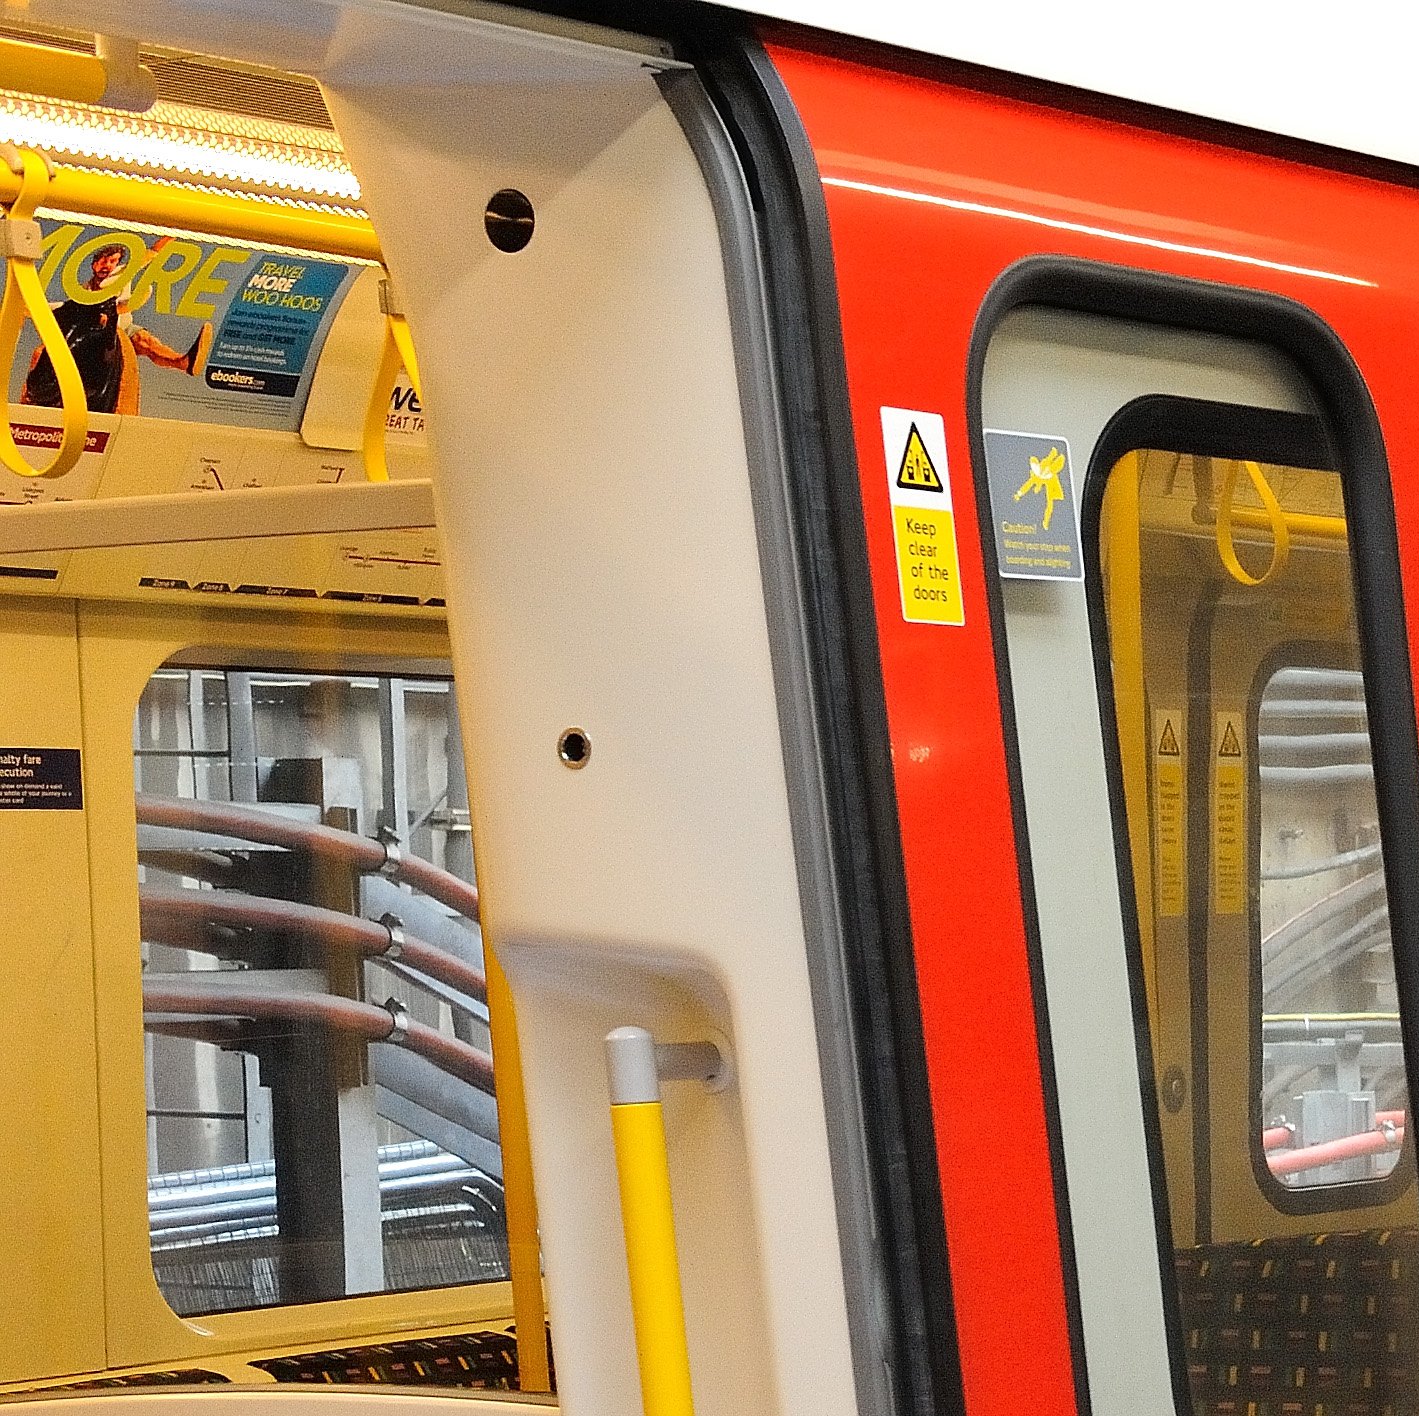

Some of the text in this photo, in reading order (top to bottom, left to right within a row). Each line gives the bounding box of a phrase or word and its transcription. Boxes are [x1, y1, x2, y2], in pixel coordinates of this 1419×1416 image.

[248, 274, 297, 292] MORE
[242, 290, 323, 312] WOO HOOS
[905, 517, 937, 539] Keep
[1002, 520, 1037, 535] Caution!
[908, 540, 937, 558] clear
[911, 562, 949, 581] of the
[913, 585, 948, 602] doors
[23, 754, 42, 764] fare
